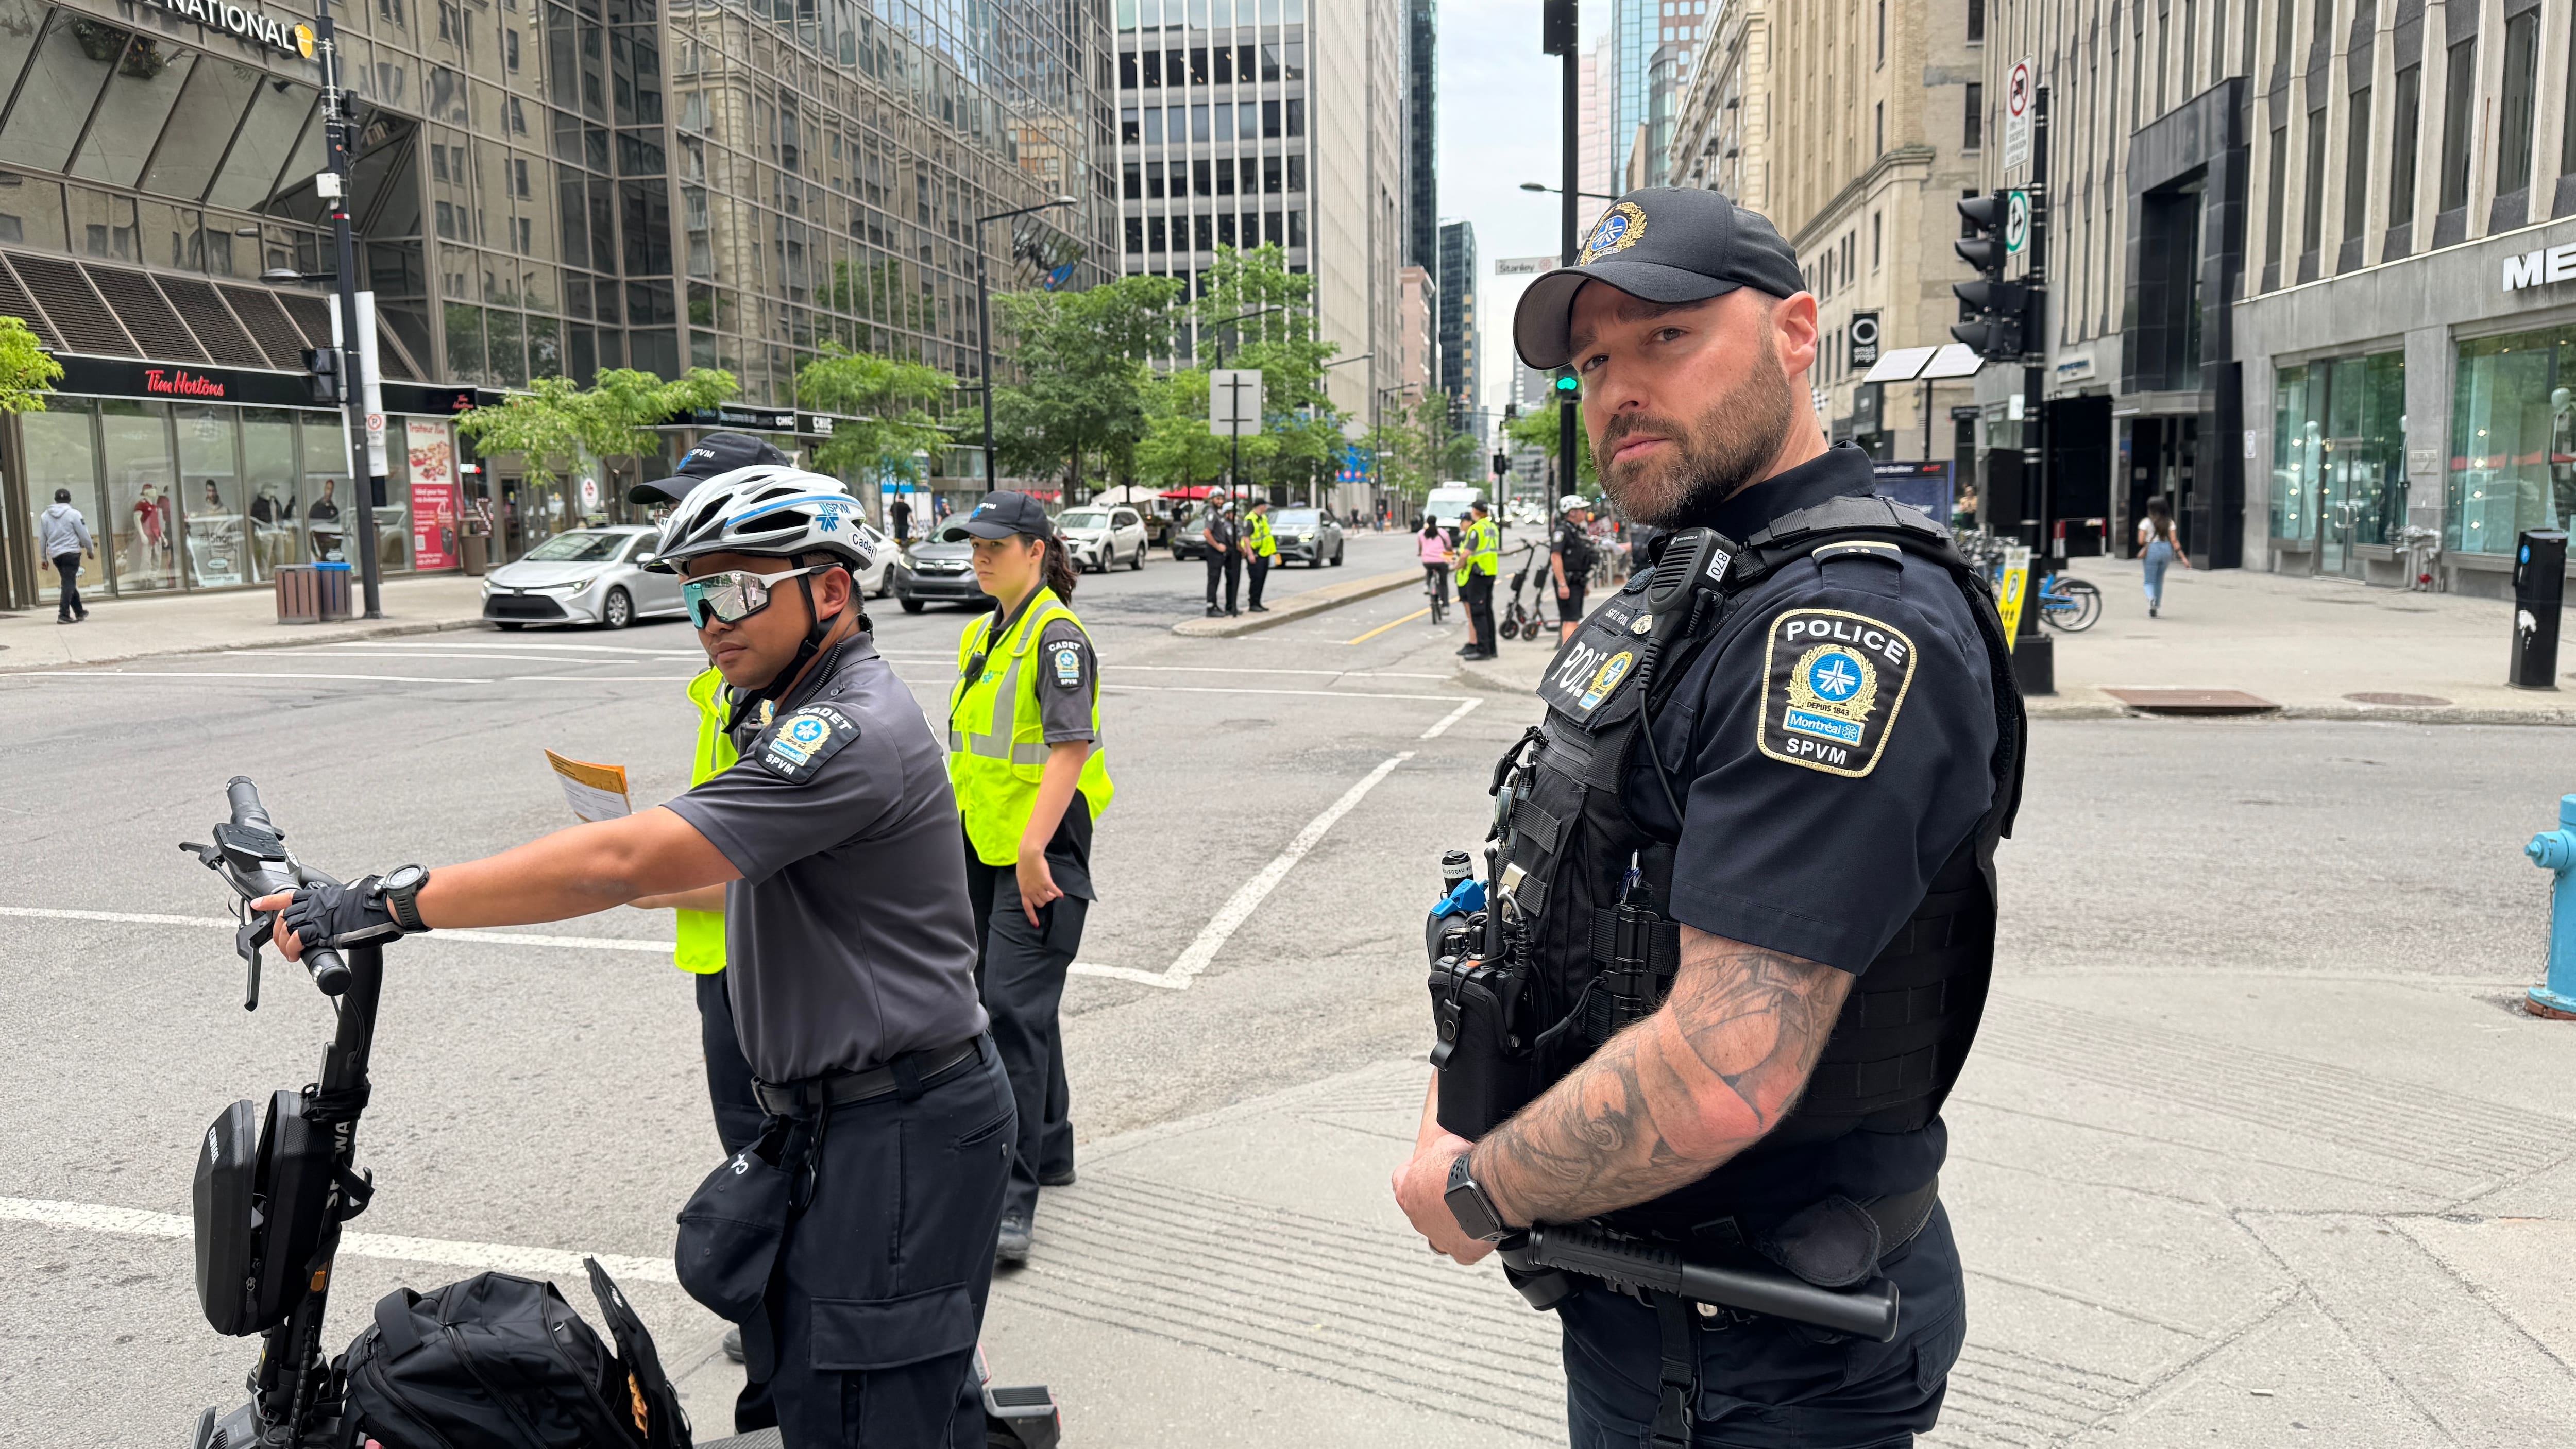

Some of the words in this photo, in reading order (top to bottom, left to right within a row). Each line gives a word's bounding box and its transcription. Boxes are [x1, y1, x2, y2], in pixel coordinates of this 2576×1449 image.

[1500, 263, 1535, 273] Stanley
[2503, 241, 2576, 293] ME
[145, 369, 173, 394] Tim
[174, 370, 225, 397] Hortons
[690, 448, 715, 459] SPVM
[826, 503, 851, 514] SPVM
[853, 534, 874, 558] Cadet
[1711, 552, 1727, 576] 870
[1048, 641, 1080, 652] CADET
[1787, 619, 1906, 666] POLICE
[797, 707, 853, 730] CADET
[1807, 701, 1831, 712] DEPUIS
[1833, 706, 1850, 716] 1843
[1790, 713, 1842, 735] Montréal
[1786, 738, 1848, 765] SPVM
[765, 753, 796, 776] SPVM
